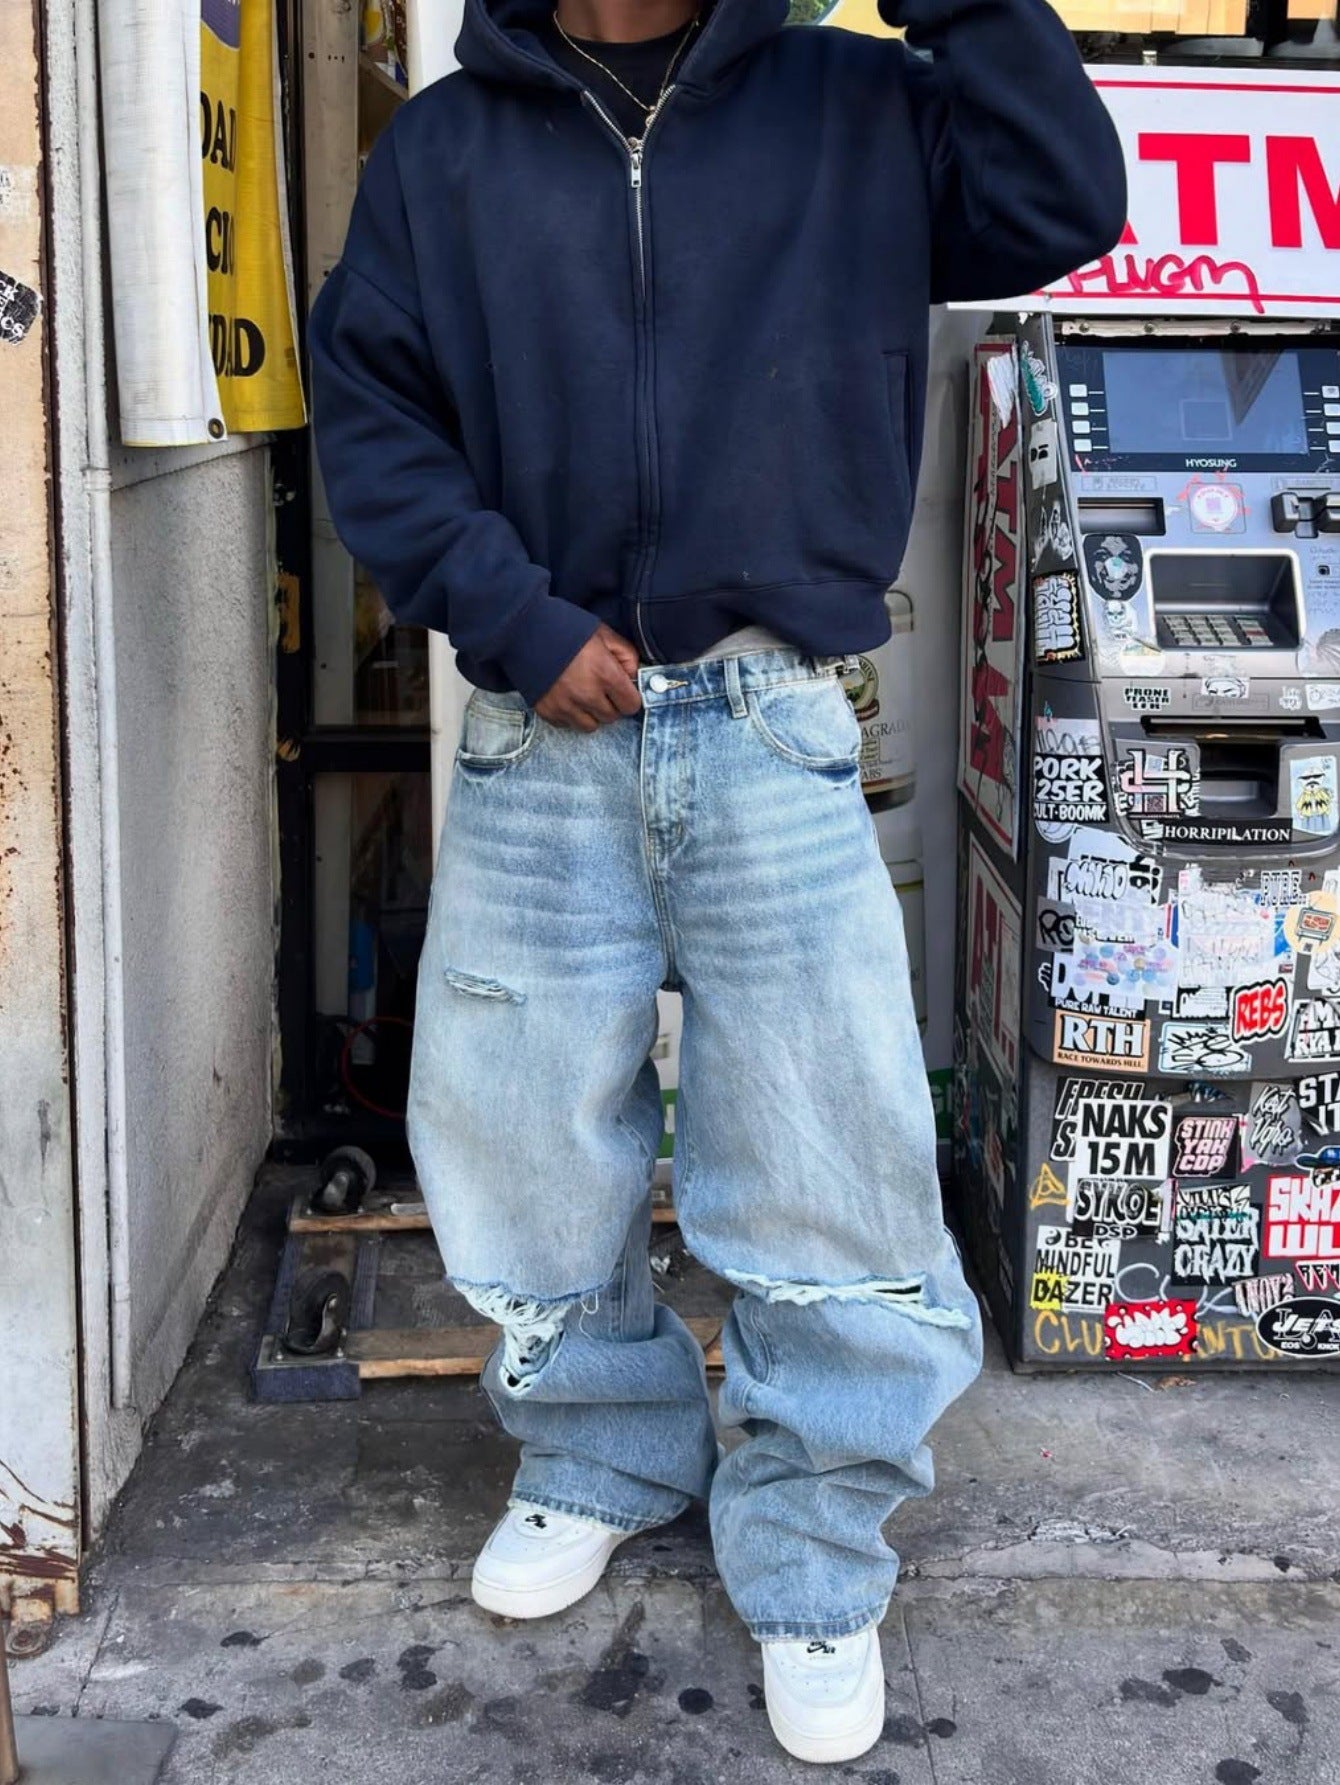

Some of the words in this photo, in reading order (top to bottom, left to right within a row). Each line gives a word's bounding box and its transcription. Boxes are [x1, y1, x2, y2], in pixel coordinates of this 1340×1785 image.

[1119, 132, 1340, 249] TM
[208, 314, 266, 378] DAD
[1185, 458, 1237, 468] HYOSUNG
[1164, 825, 1291, 841] HORRIPILATION
[1103, 1005, 1138, 1018] TALENT
[1233, 979, 1286, 1039] REBS
[1058, 1014, 1146, 1059] RTH
[1057, 1051, 1079, 1062] RACE
[1080, 1055, 1122, 1066] TOWARDS
[1081, 1102, 1168, 1140] NAKS
[1181, 1119, 1236, 1138] STINK
[1184, 1138, 1229, 1155] YAK
[1093, 1222, 1137, 1239] DSP
[1035, 1248, 1115, 1278] MINDFUL
[1174, 1243, 1256, 1284] CRAZY
[1033, 1278, 1113, 1306] DAZER
